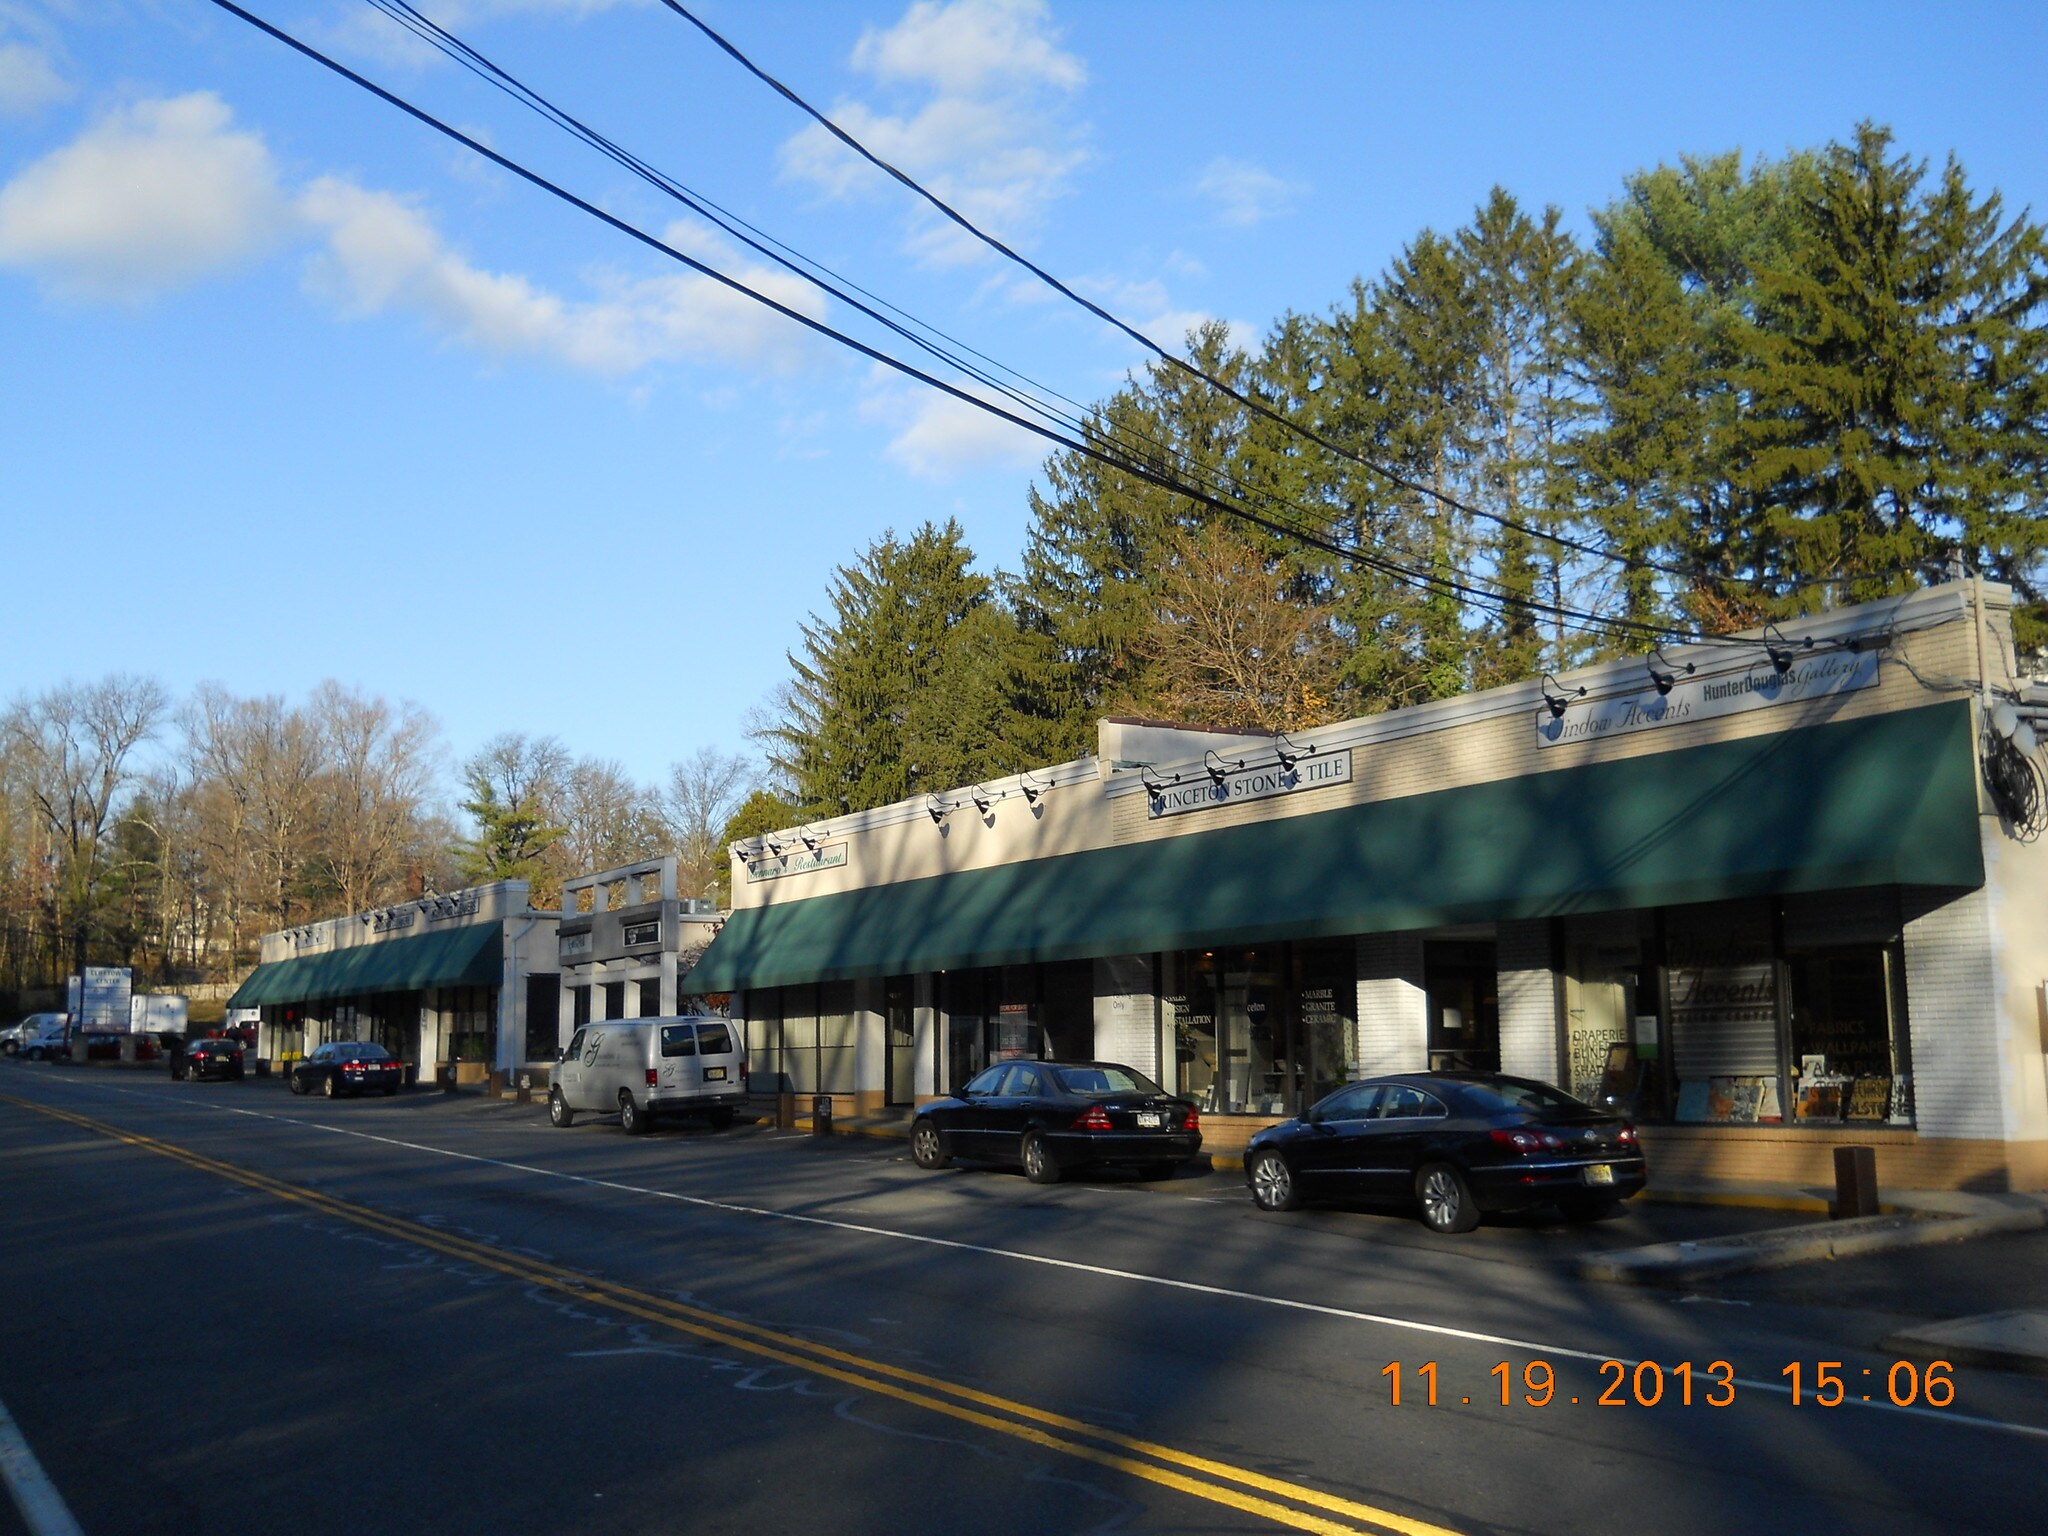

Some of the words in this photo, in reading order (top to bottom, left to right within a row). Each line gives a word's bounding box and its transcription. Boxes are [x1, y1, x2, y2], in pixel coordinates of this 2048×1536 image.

[1616, 696, 1691, 728] Accents
[1791, 658, 1862, 695] Gallery
[1152, 782, 1230, 812] PRINCETON
[1234, 772, 1286, 797] STONE
[1291, 769, 1302, 784] &
[1306, 758, 1343, 782] TILE
[794, 853, 842, 871] Restaurant
[1304, 988, 1333, 999] MARBLE
[1304, 1001, 1336, 1012] GRANITE
[1174, 1015, 1212, 1025] STALLATION
[1573, 1029, 1626, 1042] DRAPERIE
[1573, 1048, 1607, 1059] BLIND
